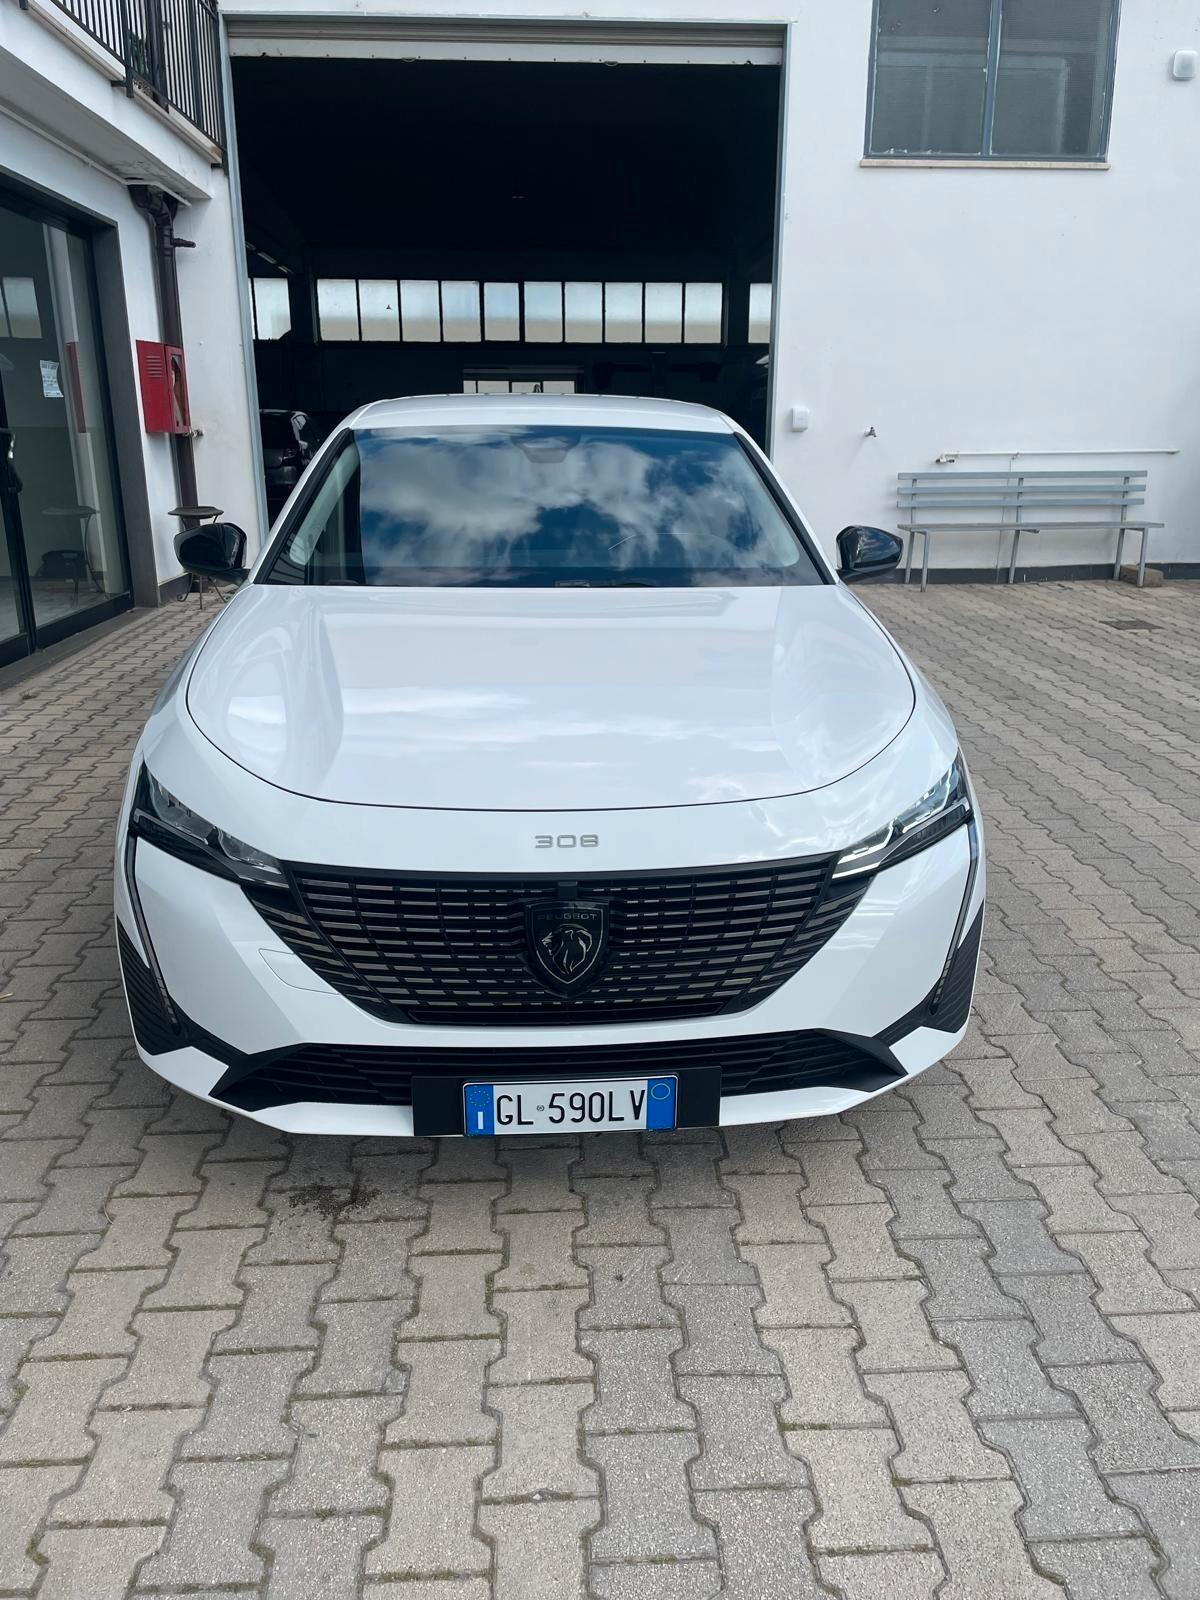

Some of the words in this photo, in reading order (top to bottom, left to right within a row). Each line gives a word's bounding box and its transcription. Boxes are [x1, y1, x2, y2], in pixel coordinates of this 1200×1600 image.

[534, 834, 599, 848] 308
[496, 1094, 534, 1126] GL
[548, 1089, 646, 1124] 590LV
